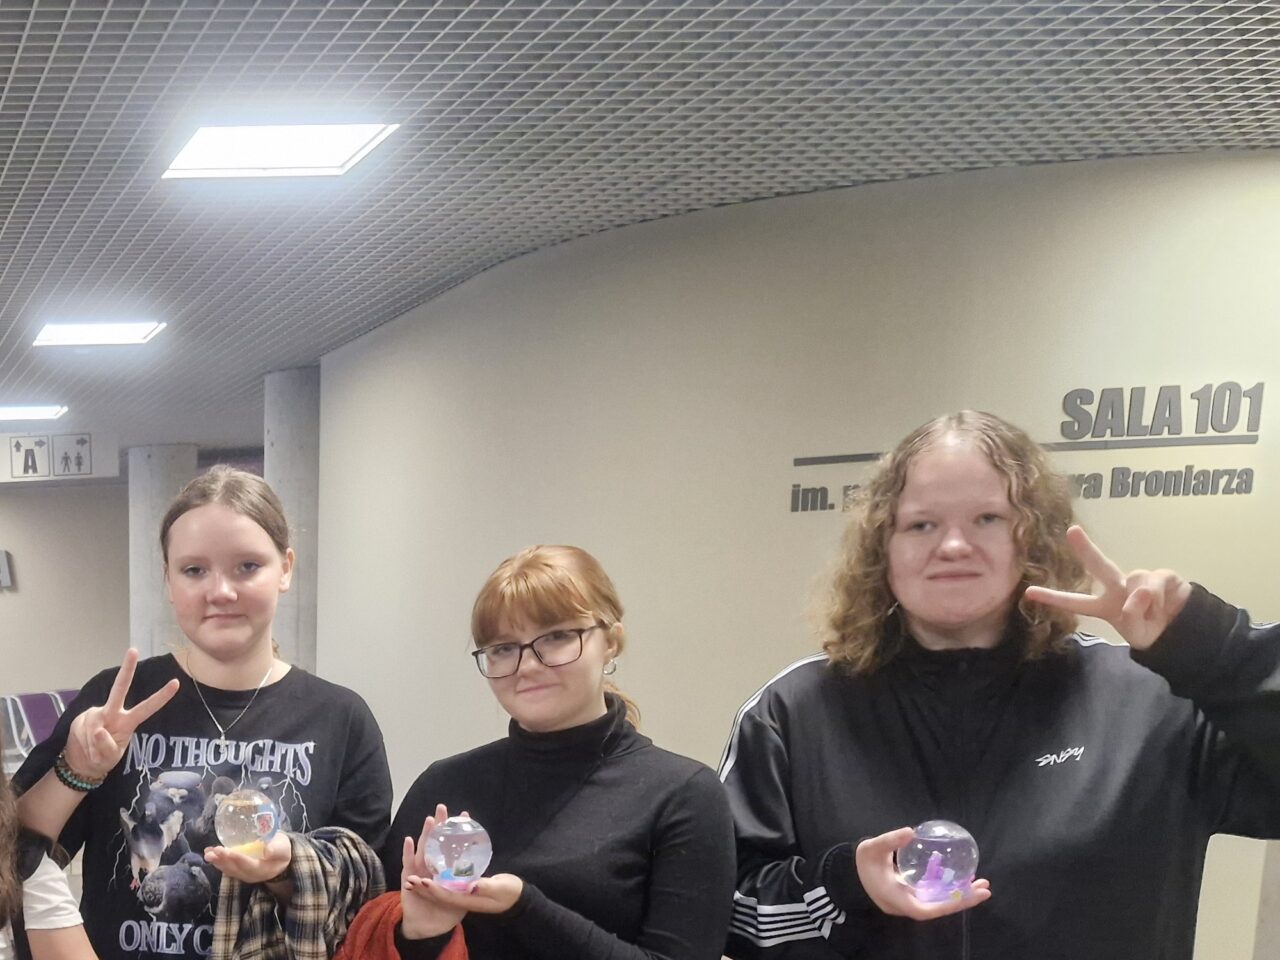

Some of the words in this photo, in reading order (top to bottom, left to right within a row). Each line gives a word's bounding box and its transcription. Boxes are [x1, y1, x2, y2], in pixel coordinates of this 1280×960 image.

[1060, 384, 1183, 440] SALA
[1191, 381, 1264, 434] 101
[23, 449, 38, 474] A
[791, 484, 835, 512] im.
[1109, 465, 1254, 498] Broniarza
[123, 732, 166, 775] NO
[170, 736, 316, 786] THOUGHTS
[119, 920, 192, 954] ONLY
